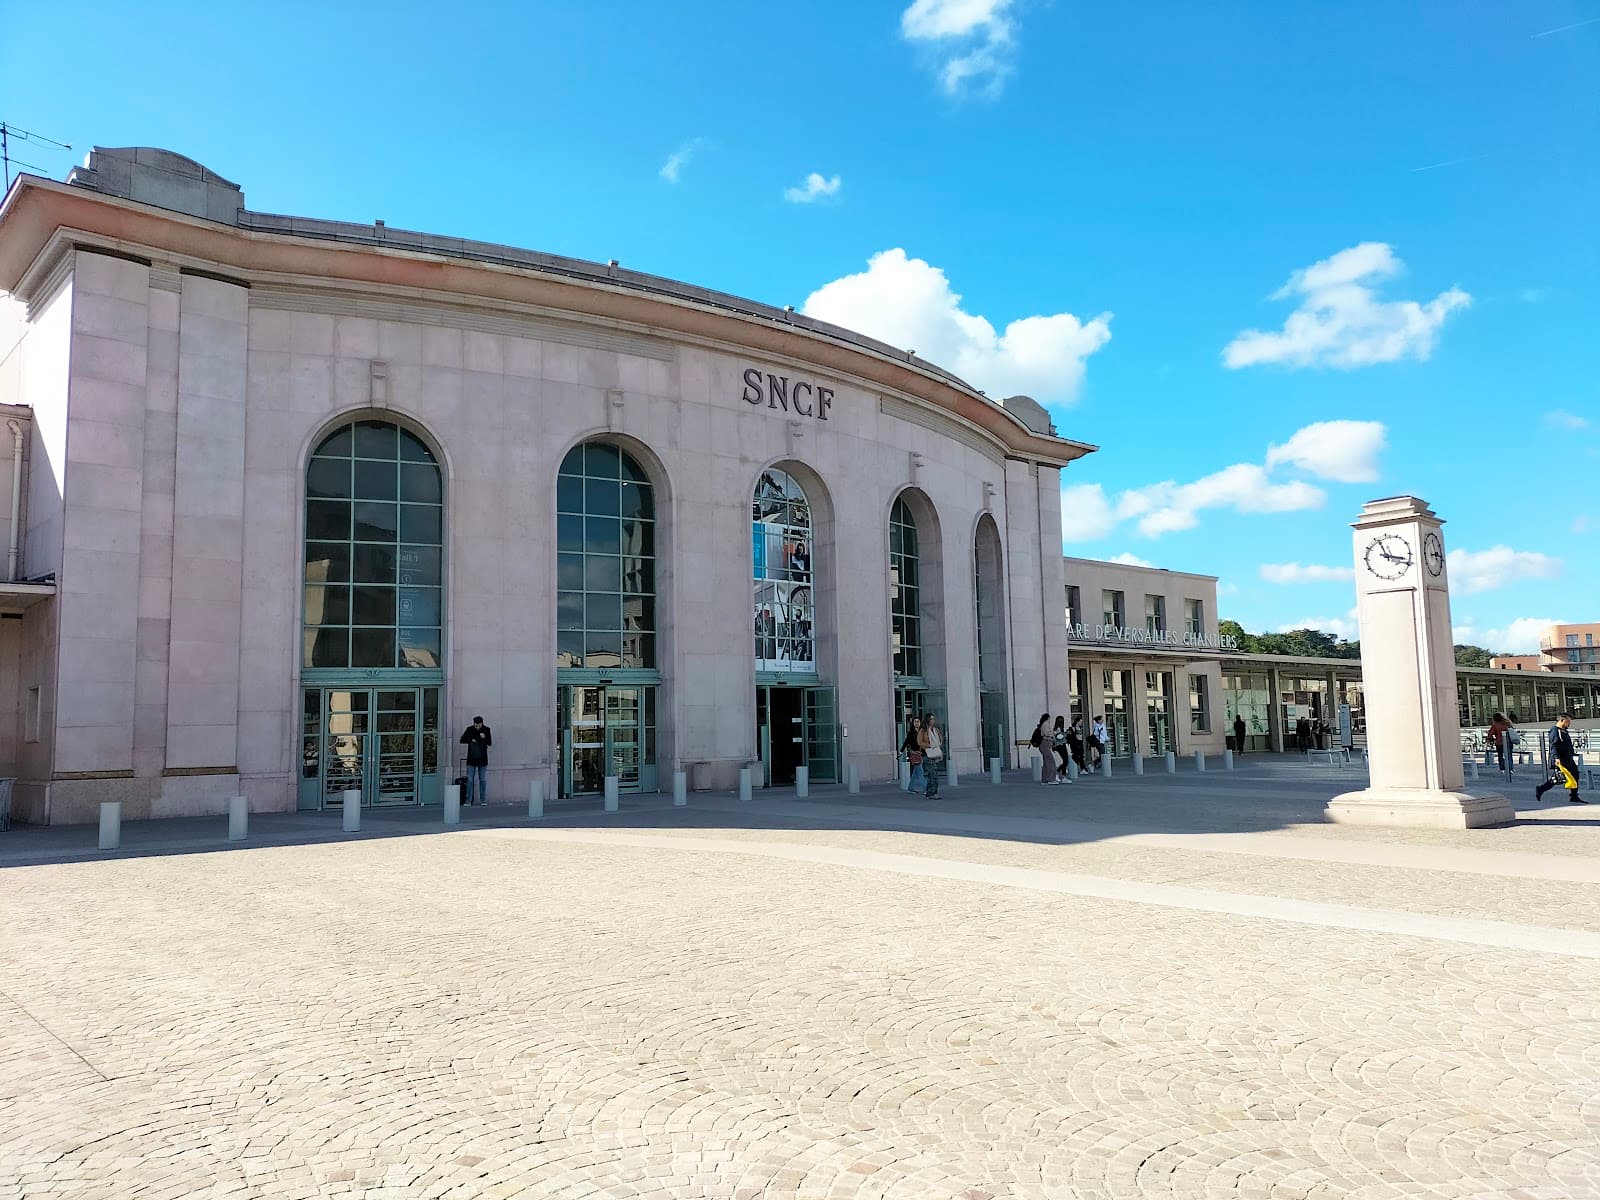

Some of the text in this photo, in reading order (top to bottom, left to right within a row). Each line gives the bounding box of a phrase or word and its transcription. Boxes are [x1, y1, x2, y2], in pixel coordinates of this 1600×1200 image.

[742, 368, 834, 420] SNCF
[1067, 623, 1237, 648] ARE DE VERSAILLES CHANTIERS
